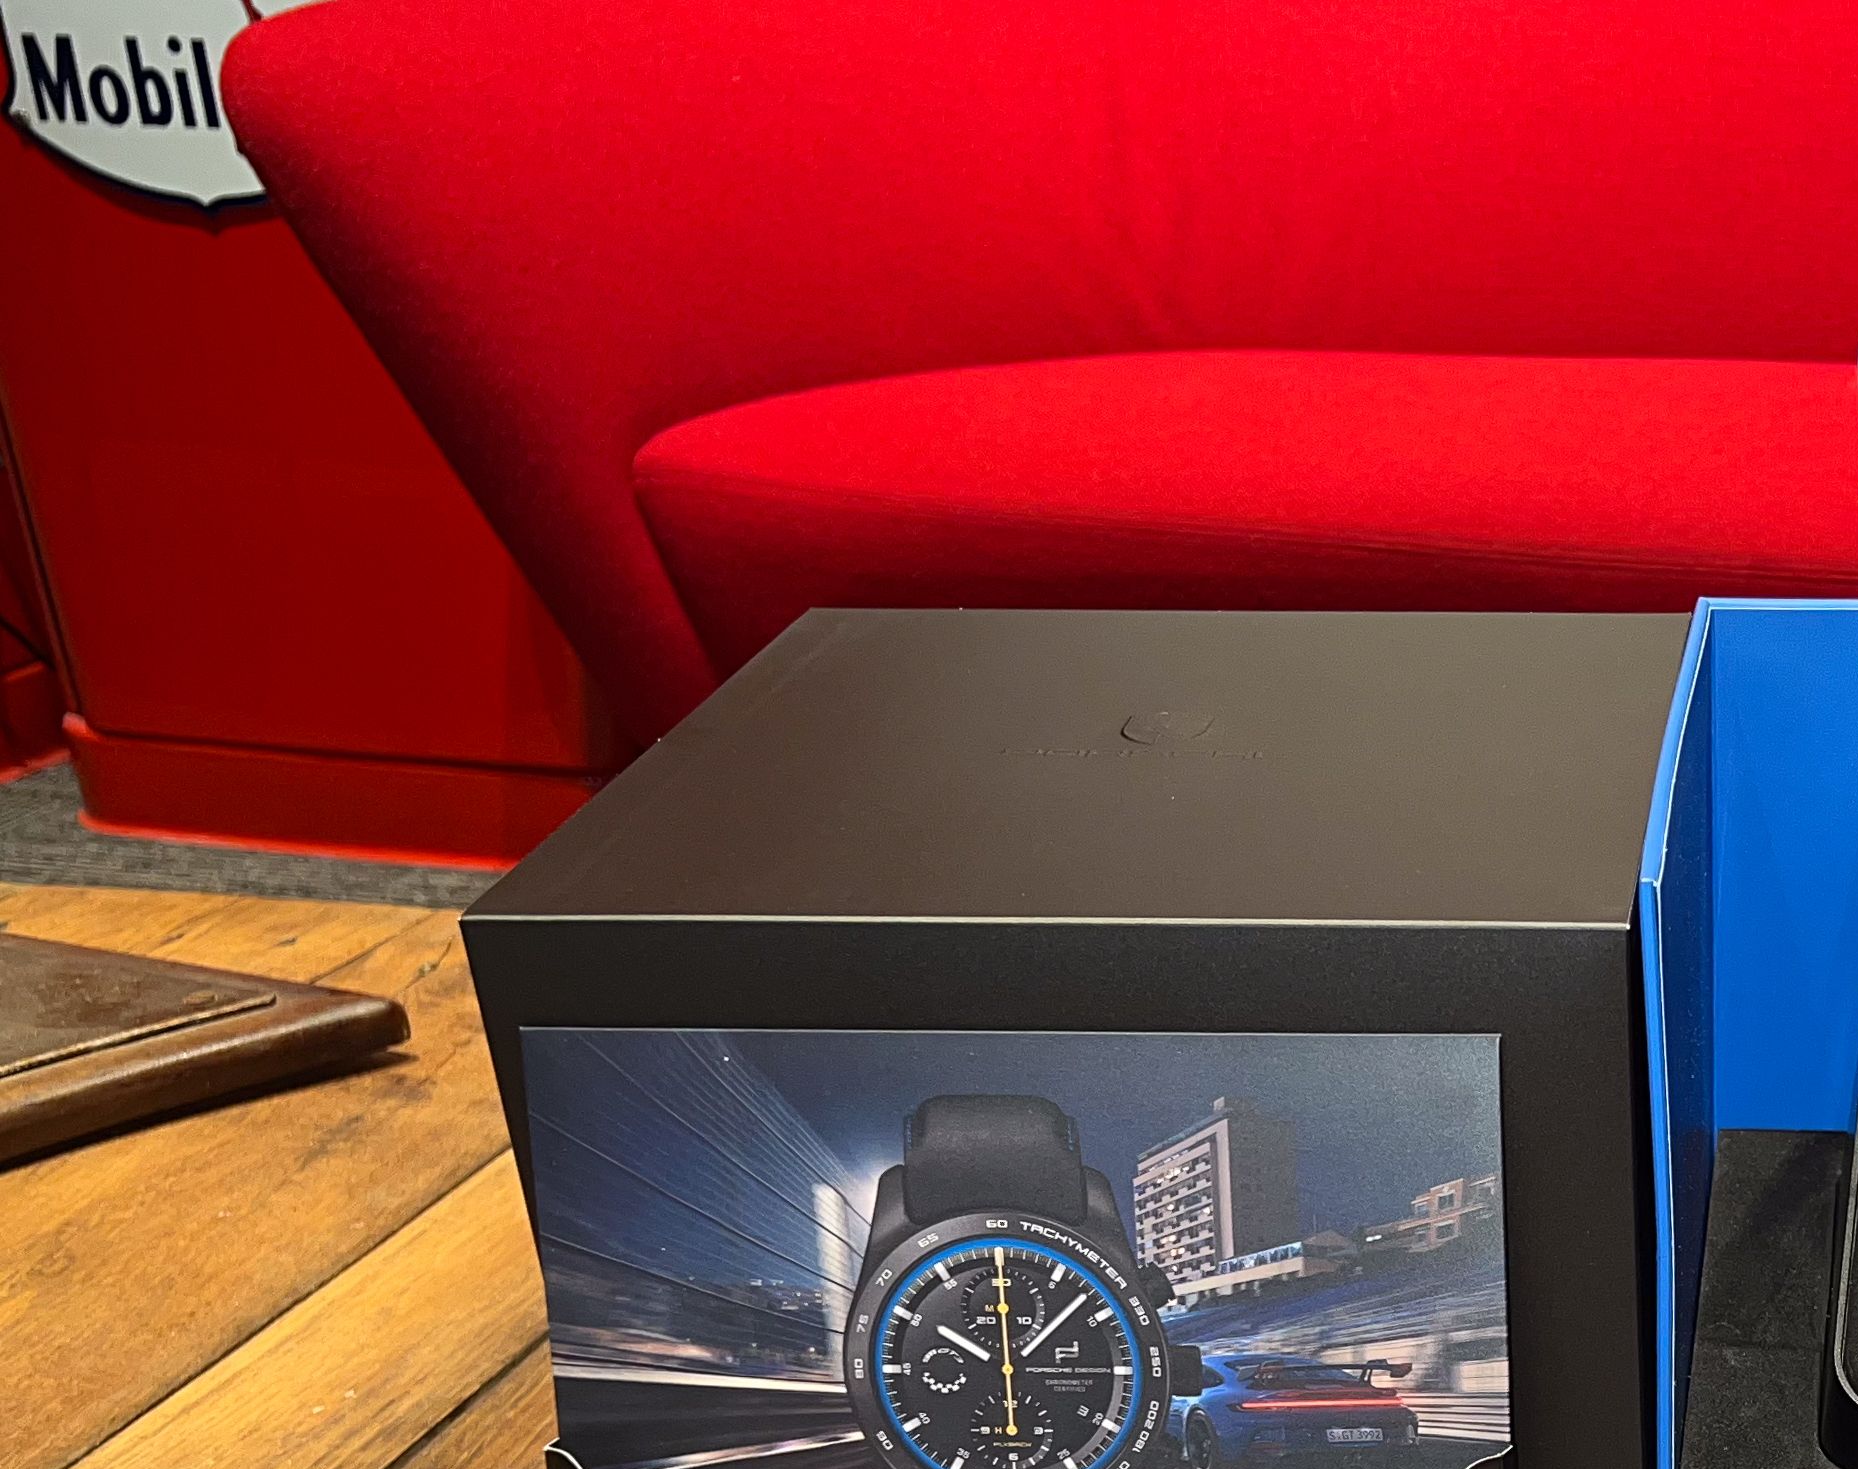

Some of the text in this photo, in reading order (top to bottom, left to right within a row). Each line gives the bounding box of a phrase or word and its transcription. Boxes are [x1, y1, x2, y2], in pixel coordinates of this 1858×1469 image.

[20, 33, 221, 129] Mobil
[986, 1220, 1008, 1228] 60
[918, 1232, 940, 1248] 65
[1020, 1221, 1128, 1290] TACHYMETER
[876, 1268, 892, 1286] 70
[856, 1314, 870, 1333] 75
[976, 1316, 997, 1324] 20
[1016, 1316, 1032, 1324] 10
[1086, 1316, 1098, 1328] 10
[1149, 1346, 1162, 1377] 250
[918, 1412, 930, 1424] 40
[1092, 1412, 1104, 1426] 20
[1144, 1400, 1160, 1430] 200
[875, 1430, 894, 1450] 90
[1132, 1430, 1150, 1454] 180
[956, 1448, 971, 1459] 35
[1056, 1448, 1072, 1460] 25
